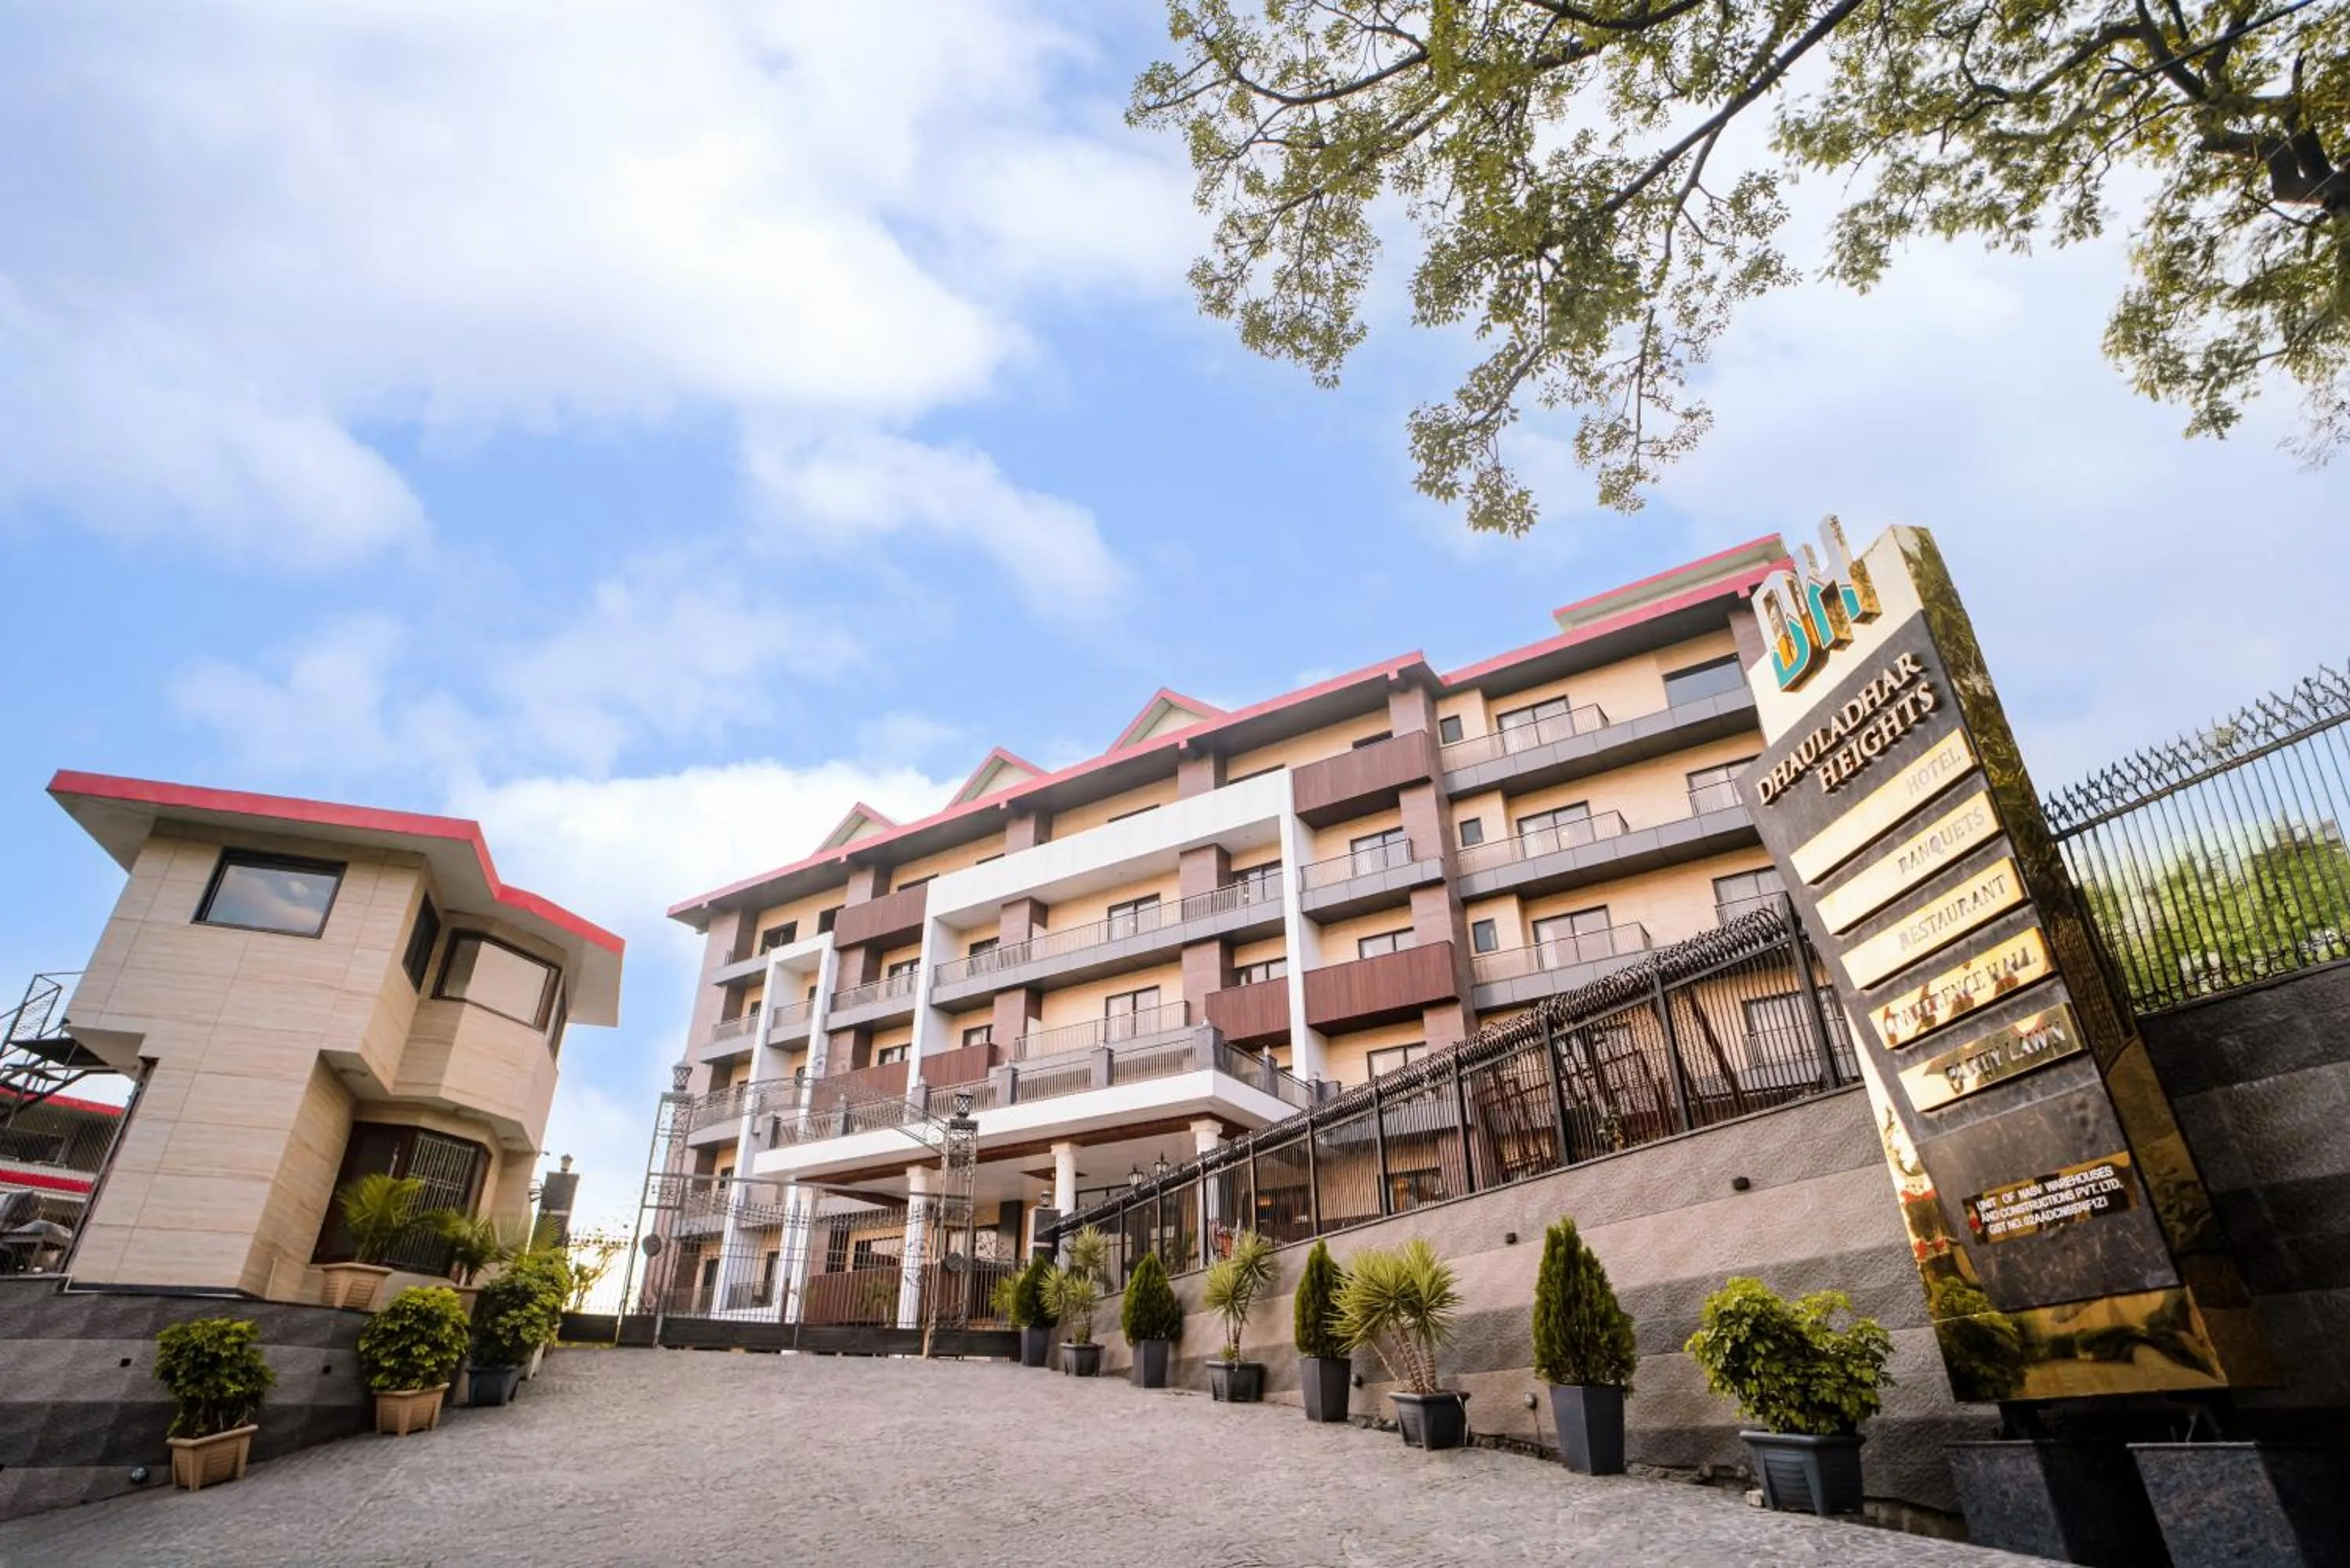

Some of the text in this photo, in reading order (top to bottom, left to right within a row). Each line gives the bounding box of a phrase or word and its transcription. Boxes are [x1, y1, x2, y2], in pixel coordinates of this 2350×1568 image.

[1756, 652, 1923, 805] DHAULADHAR
[1816, 682, 1936, 793] HEIGHTS
[1907, 747, 1961, 794] HOTEL
[1898, 807, 1986, 875] BANQUETS
[1899, 874, 2006, 951] RESTAURANT
[1986, 945, 2037, 984] HALL
[2005, 1021, 2066, 1062] LAWN
[1976, 1196, 1996, 1211] UNIT
[2001, 1190, 2016, 1204] OF
[2044, 1165, 2114, 1193] WAREHOUSES
[1980, 1210, 2000, 1223] AND
[2000, 1190, 2076, 1217] CONSTRUCTIONS
